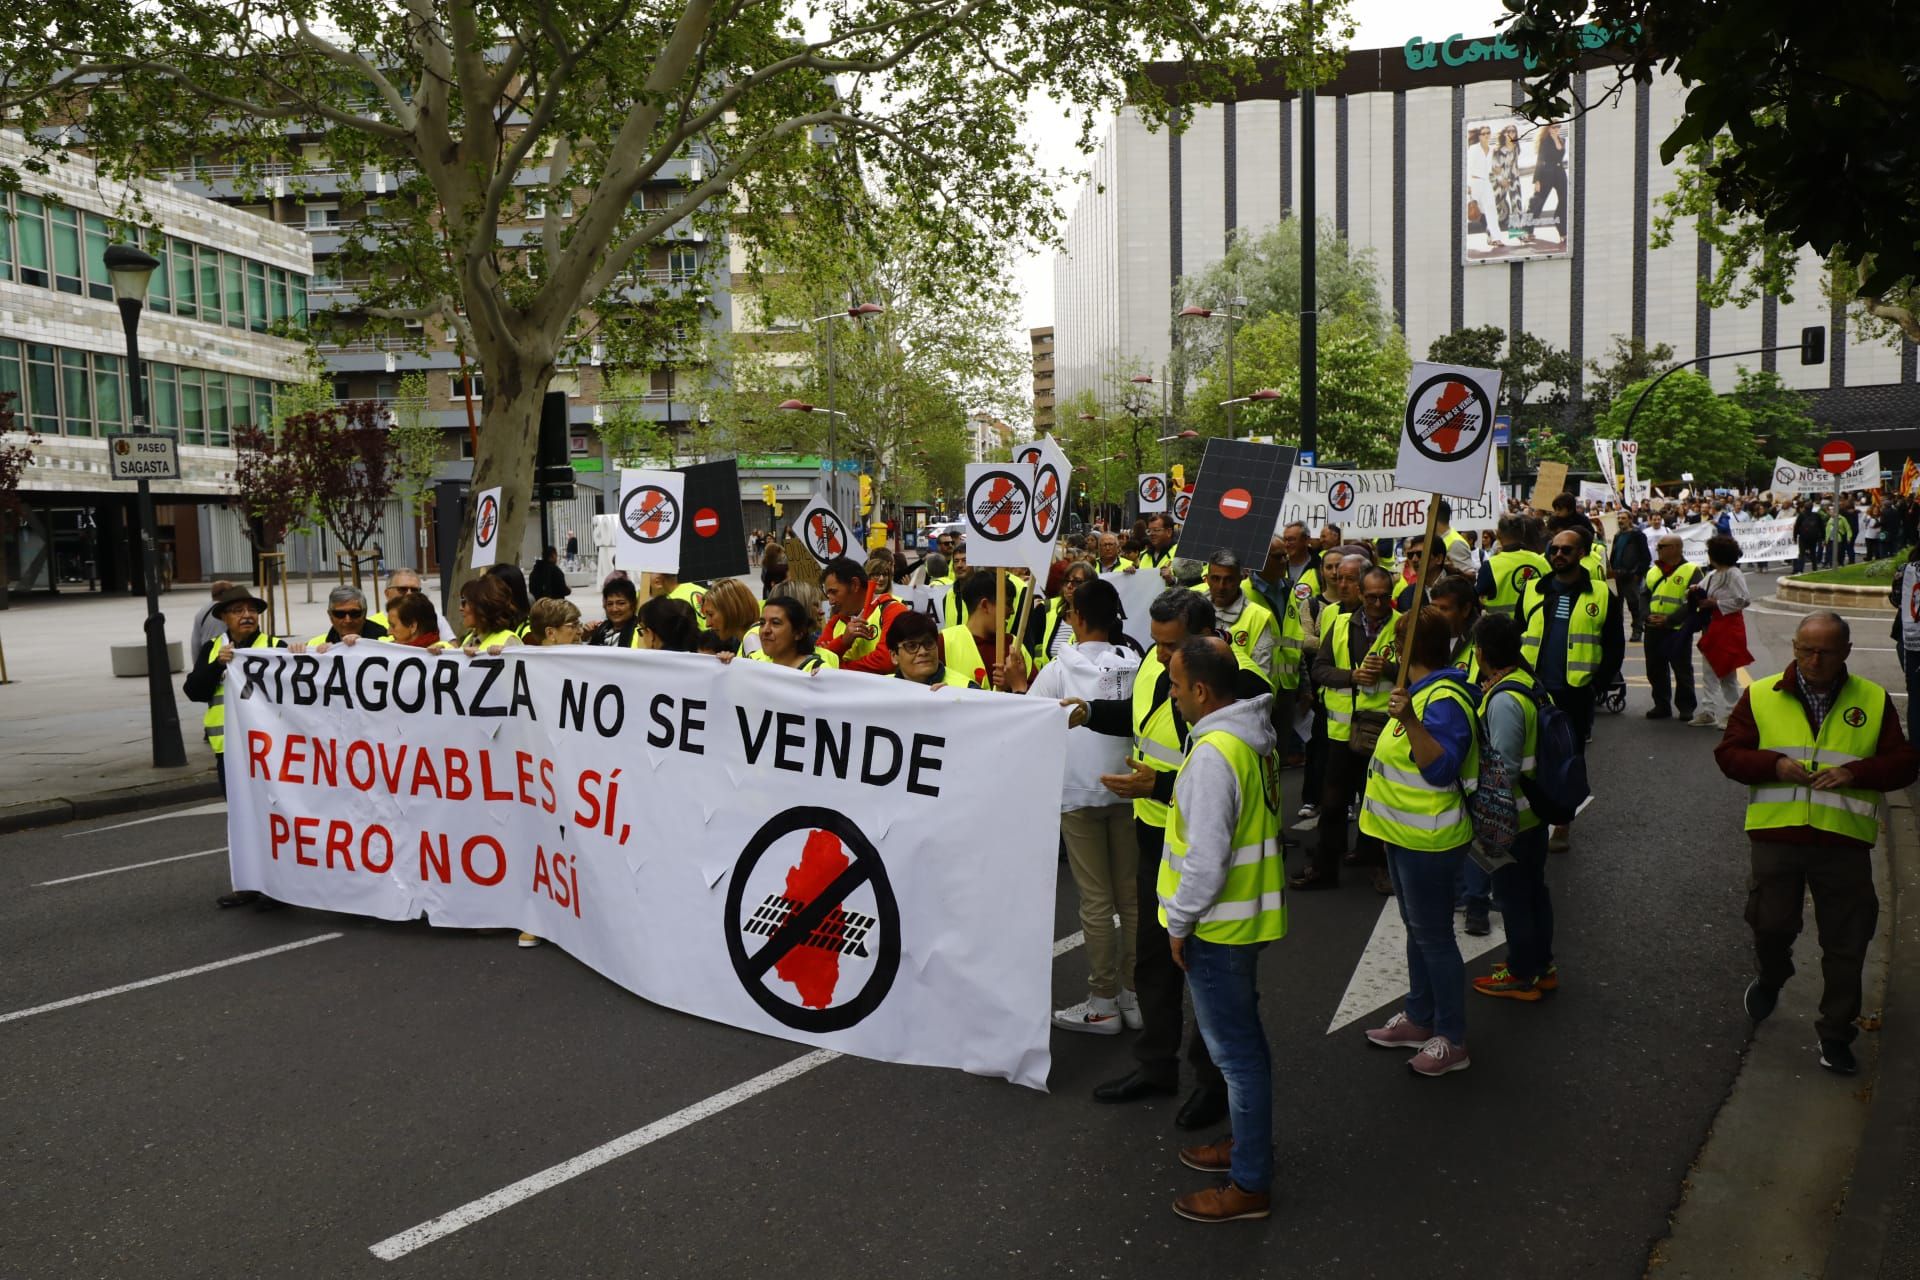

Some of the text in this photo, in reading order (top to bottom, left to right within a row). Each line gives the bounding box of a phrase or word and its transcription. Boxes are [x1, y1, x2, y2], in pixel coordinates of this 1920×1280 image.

[1404, 36, 1438, 70] El
[137, 443, 167, 453] PASEO
[1622, 443, 1637, 454] NO
[120, 460, 170, 473] SAGASTA
[1799, 471, 1815, 482] NO
[1357, 504, 1378, 528] CON
[1382, 500, 1425, 528] PLACAS
[240, 655, 946, 798] RIBAGORZA NO SE VENDE
[247, 730, 632, 846] RENOVABLES SÍ,
[269, 813, 582, 919] PERO NO ASÍ
